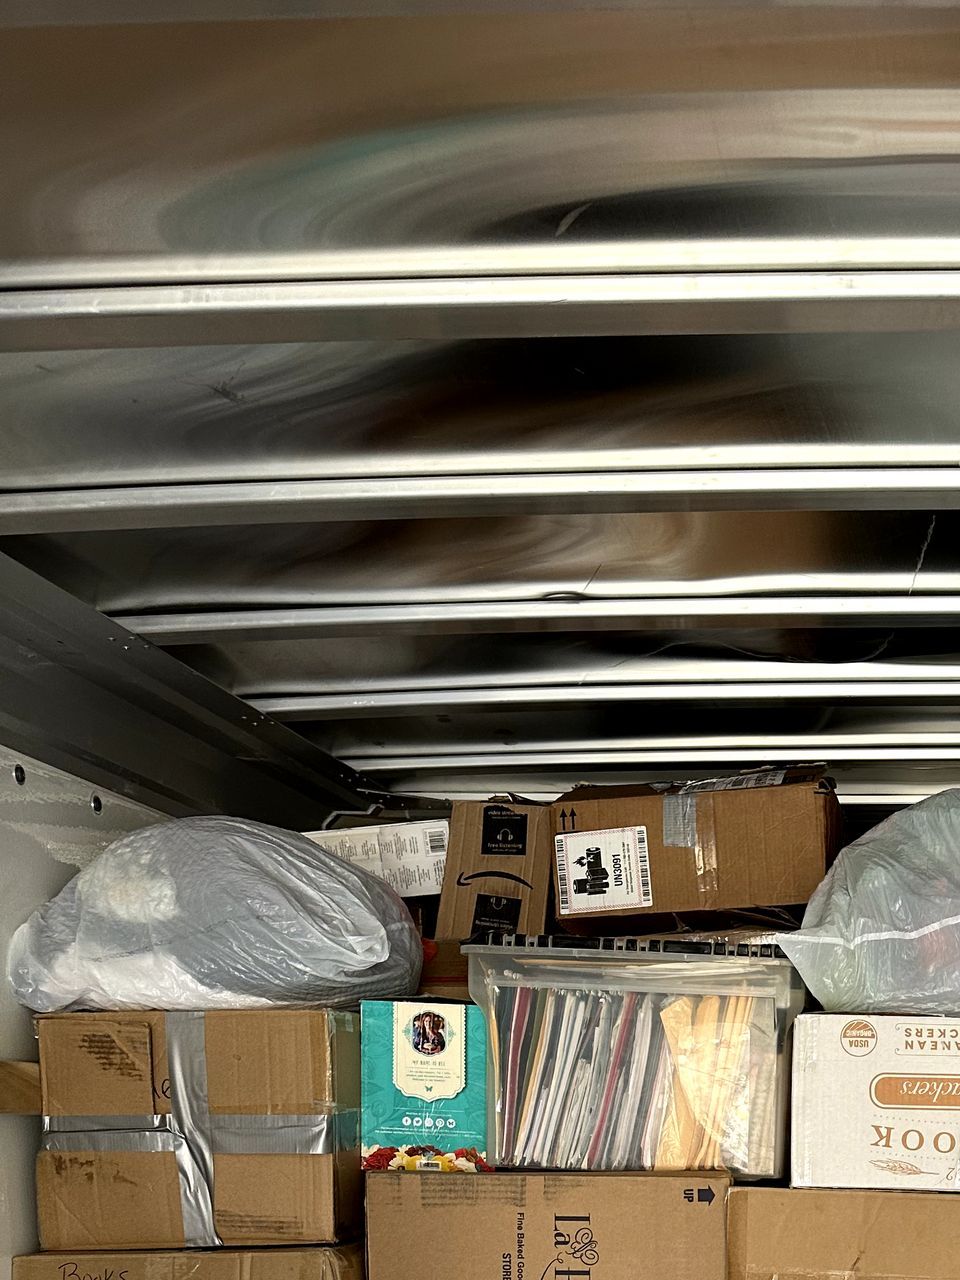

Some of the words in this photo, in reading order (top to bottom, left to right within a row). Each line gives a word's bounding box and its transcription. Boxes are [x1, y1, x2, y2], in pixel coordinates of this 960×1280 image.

[612, 853, 623, 887] UN3091
[848, 1039, 869, 1048] USDA
[683, 1188, 694, 1203] UP
[517, 1212, 525, 1231] Fine
[553, 1212, 591, 1249] La
[517, 1233, 525, 1260] Baked
